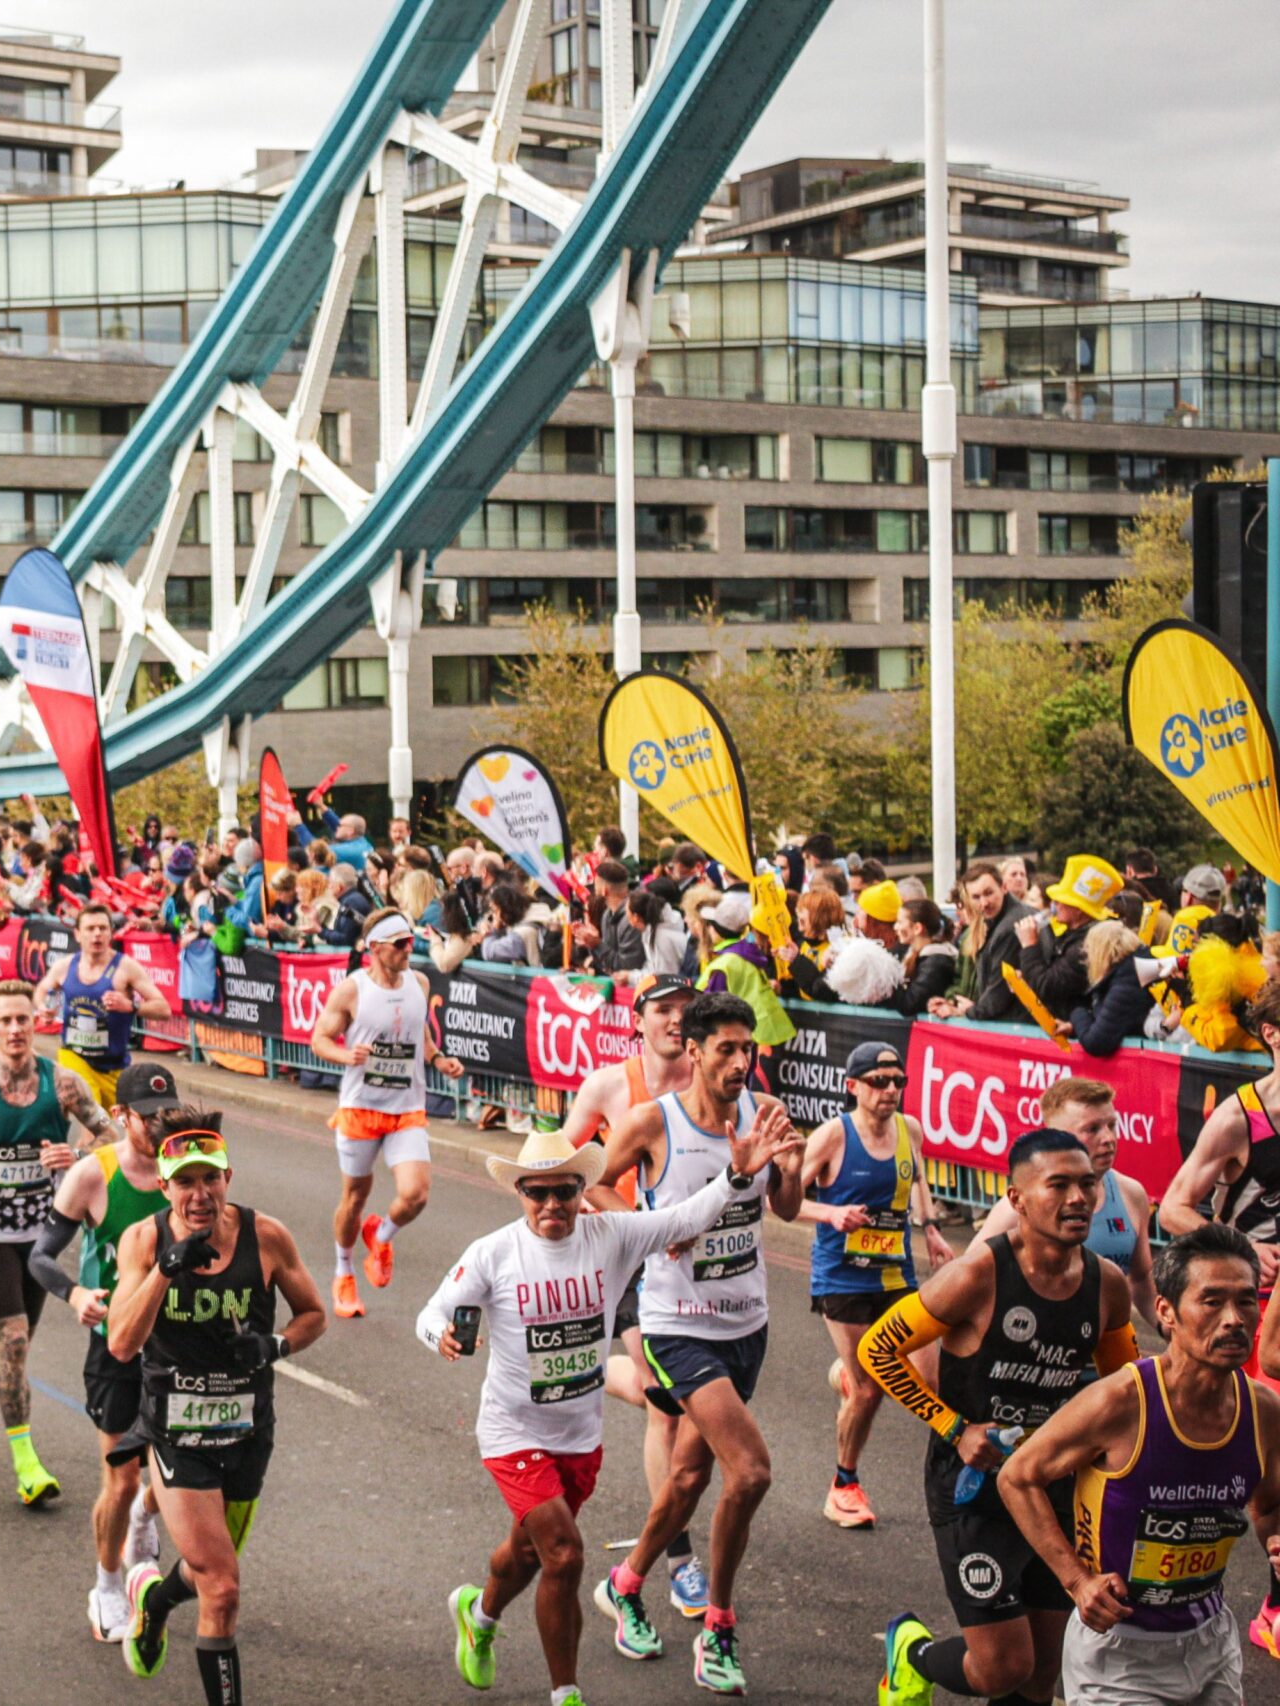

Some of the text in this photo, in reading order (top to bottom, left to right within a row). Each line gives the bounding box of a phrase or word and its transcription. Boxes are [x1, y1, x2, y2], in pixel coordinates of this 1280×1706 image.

[224, 976, 276, 1003] CONSULTANCY
[448, 980, 477, 1006] TATA
[444, 1007, 516, 1040] CONSULTANCY
[598, 1003, 631, 1029] TATA
[444, 1034, 491, 1062] SERVICES
[537, 995, 594, 1078] tcs
[921, 1045, 1008, 1156] tcs
[704, 1231, 754, 1257] 51009
[517, 1269, 605, 1317] PINOLE
[531, 1327, 563, 1349] tcs
[543, 1349, 599, 1377] 39436
[1037, 1344, 1078, 1366] MAC
[174, 1371, 206, 1392] tcs
[989, 1360, 1038, 1384] MAFIA
[182, 1402, 242, 1422] 41780
[1149, 1485, 1229, 1500] WellChild
[1145, 1514, 1188, 1541] tcs
[968, 1567, 991, 1584] MM
[1159, 1551, 1217, 1579] 5180
